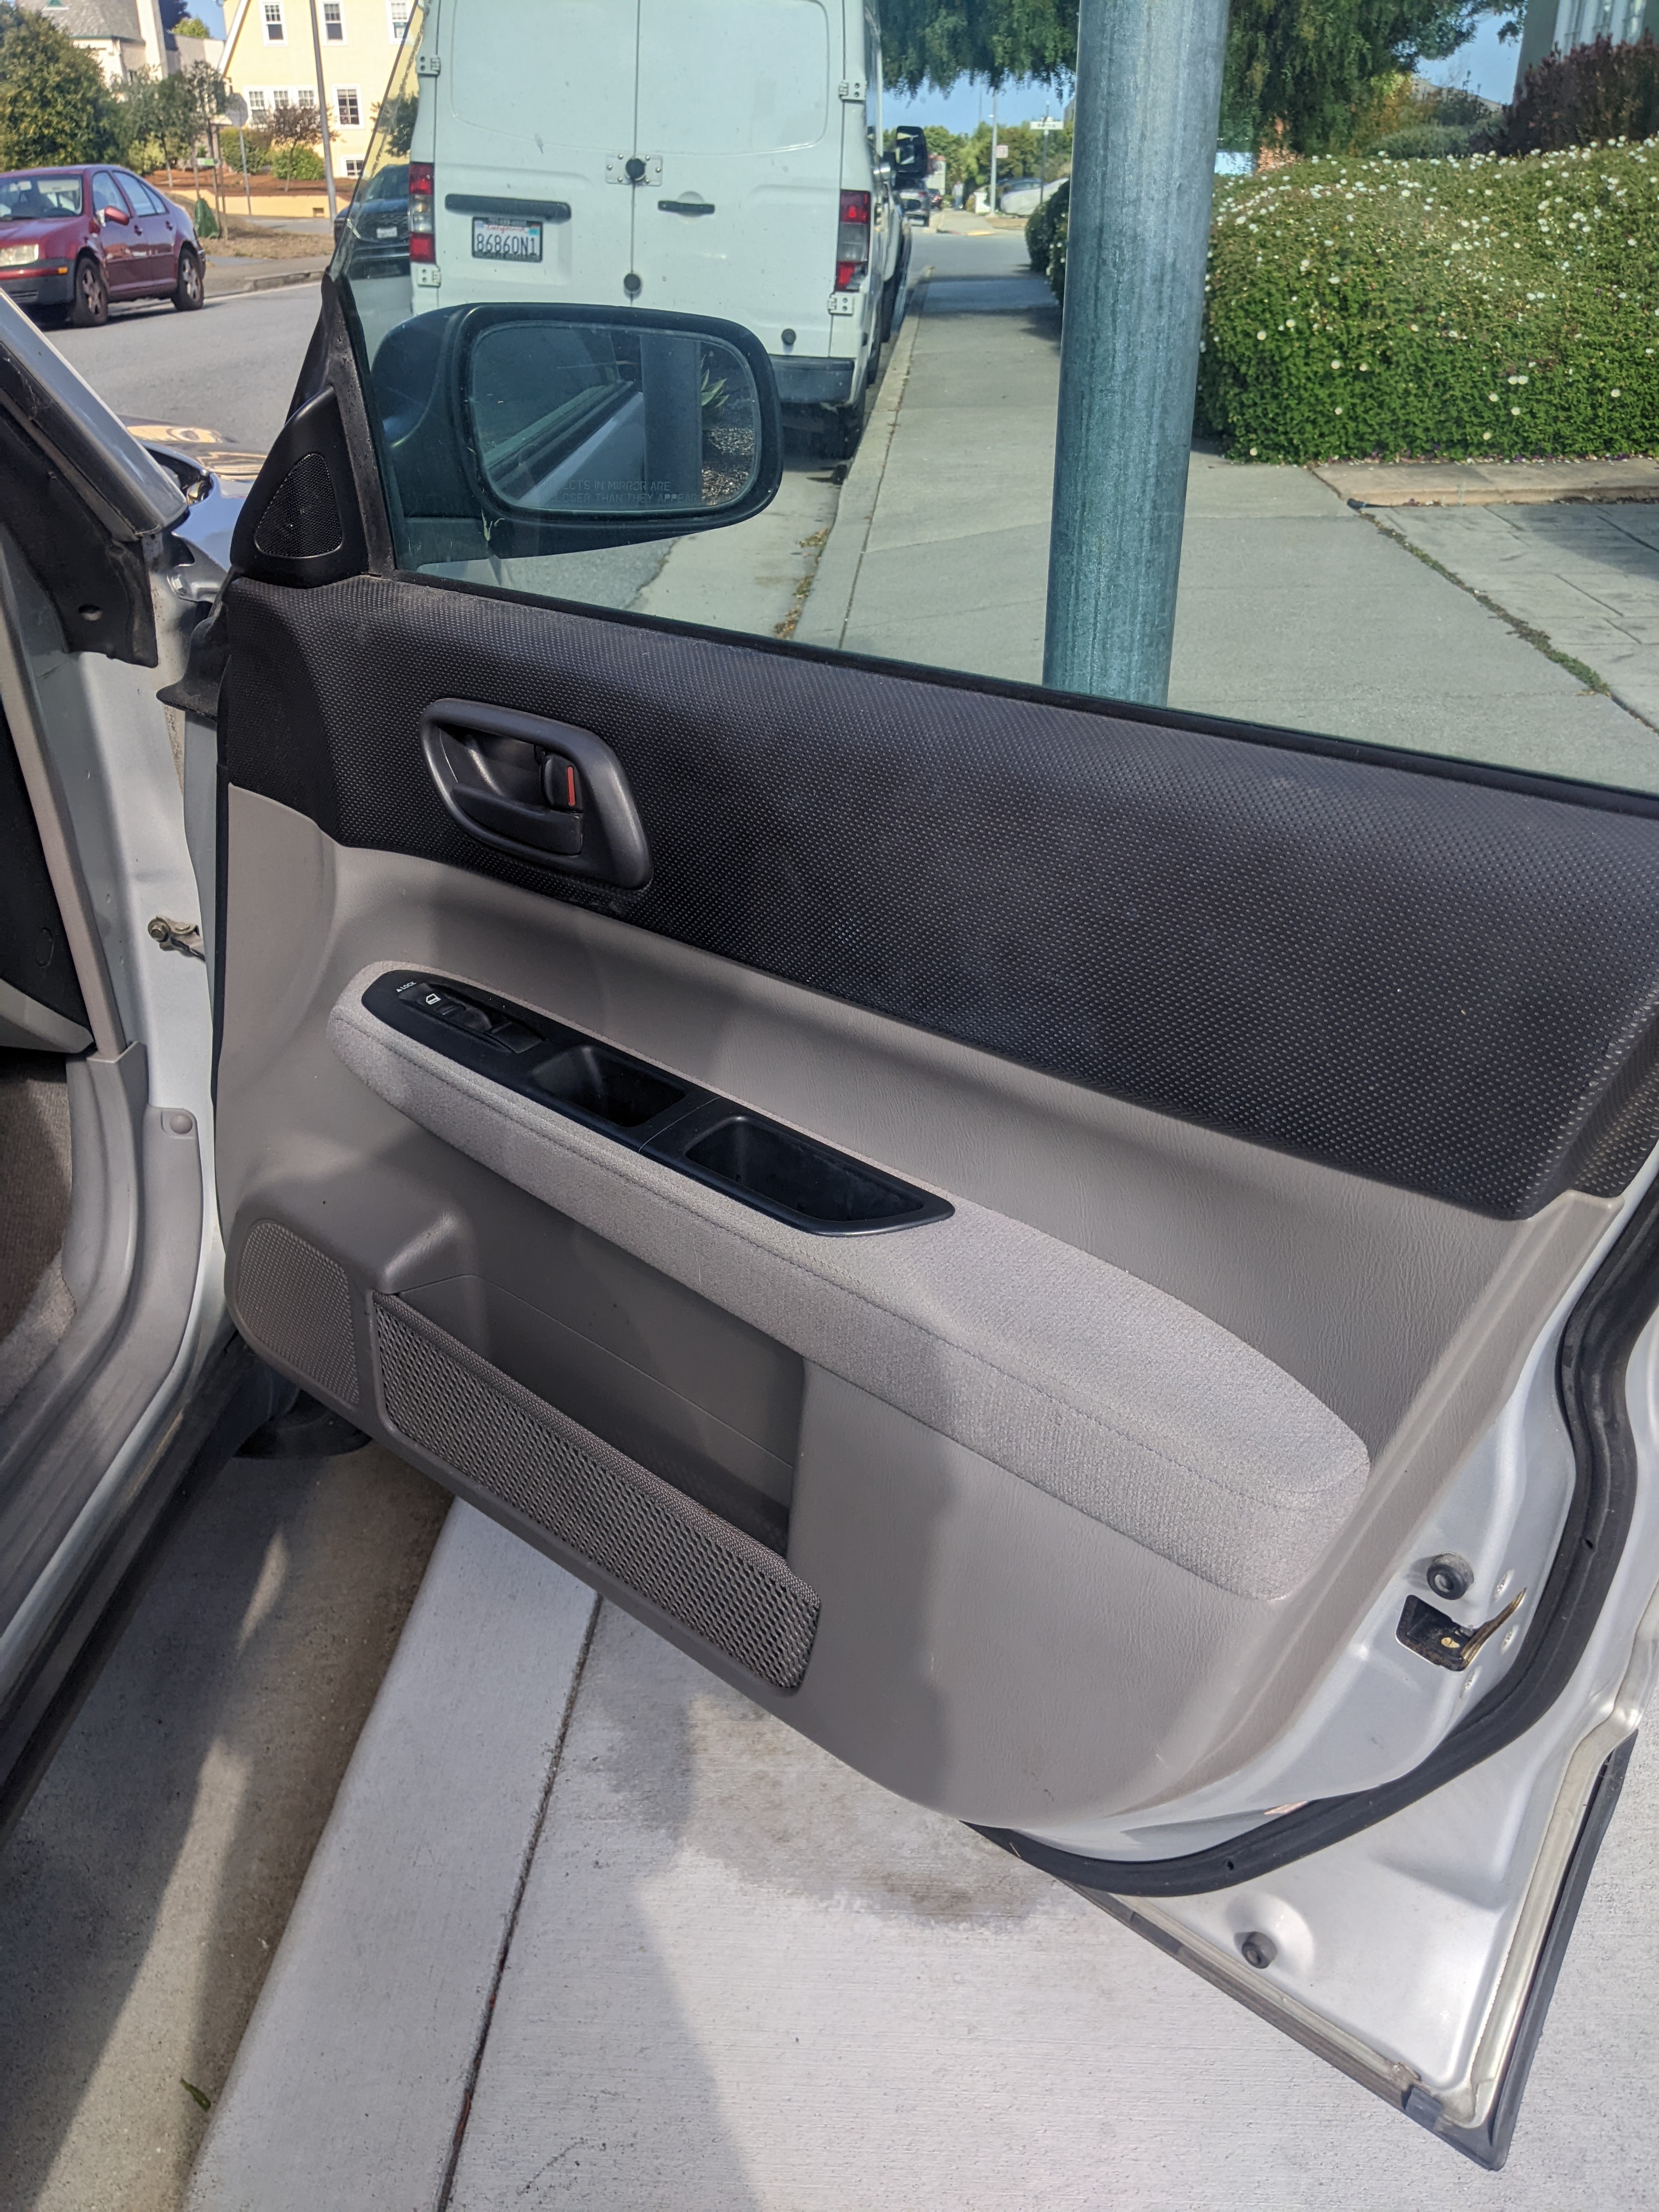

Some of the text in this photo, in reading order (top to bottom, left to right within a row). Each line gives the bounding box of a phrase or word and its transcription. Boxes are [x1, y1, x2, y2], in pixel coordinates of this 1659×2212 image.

[477, 234, 536, 255] 86860N1
[594, 481, 604, 490] IN
[608, 481, 647, 491] MIRROR
[651, 481, 670, 491] ARE
[595, 493, 623, 503] THAN
[628, 493, 653, 503] THEY
[658, 493, 697, 504] APPEAR
[400, 981, 417, 990] LOCK
